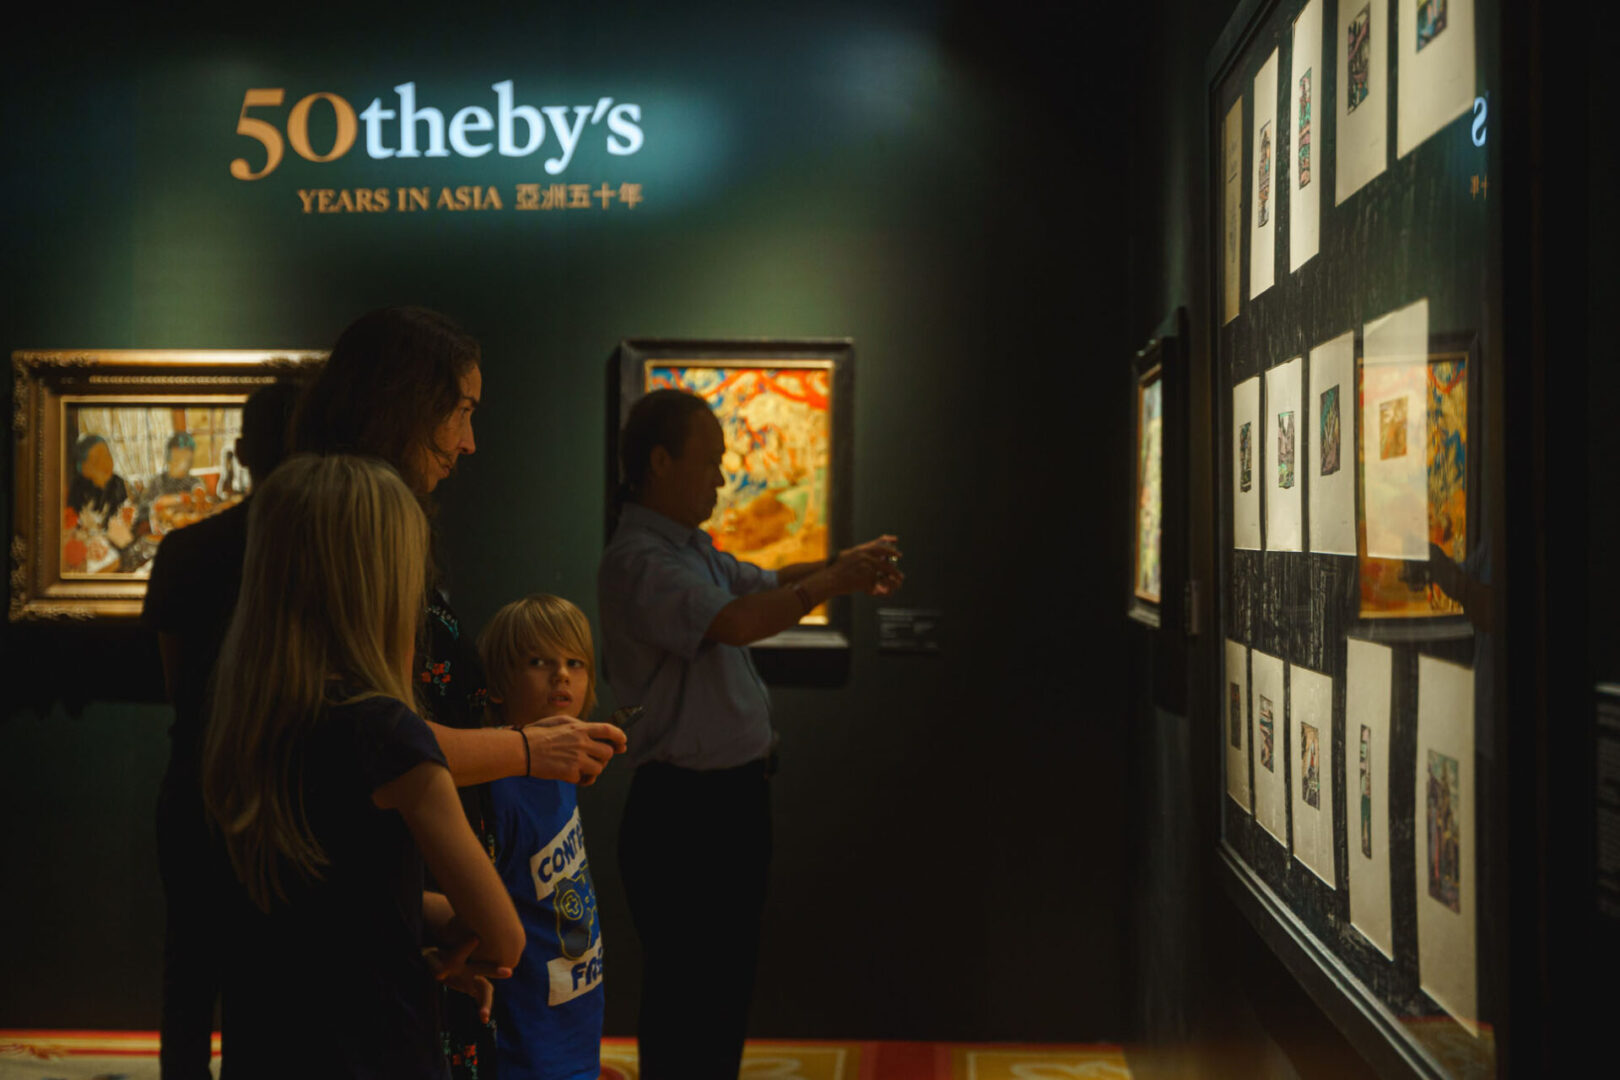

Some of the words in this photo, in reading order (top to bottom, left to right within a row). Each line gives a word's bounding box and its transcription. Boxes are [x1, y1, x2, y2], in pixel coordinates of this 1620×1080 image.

[297, 187, 391, 213] YEARS
[396, 186, 431, 212] IN
[437, 184, 503, 211] ASIA
